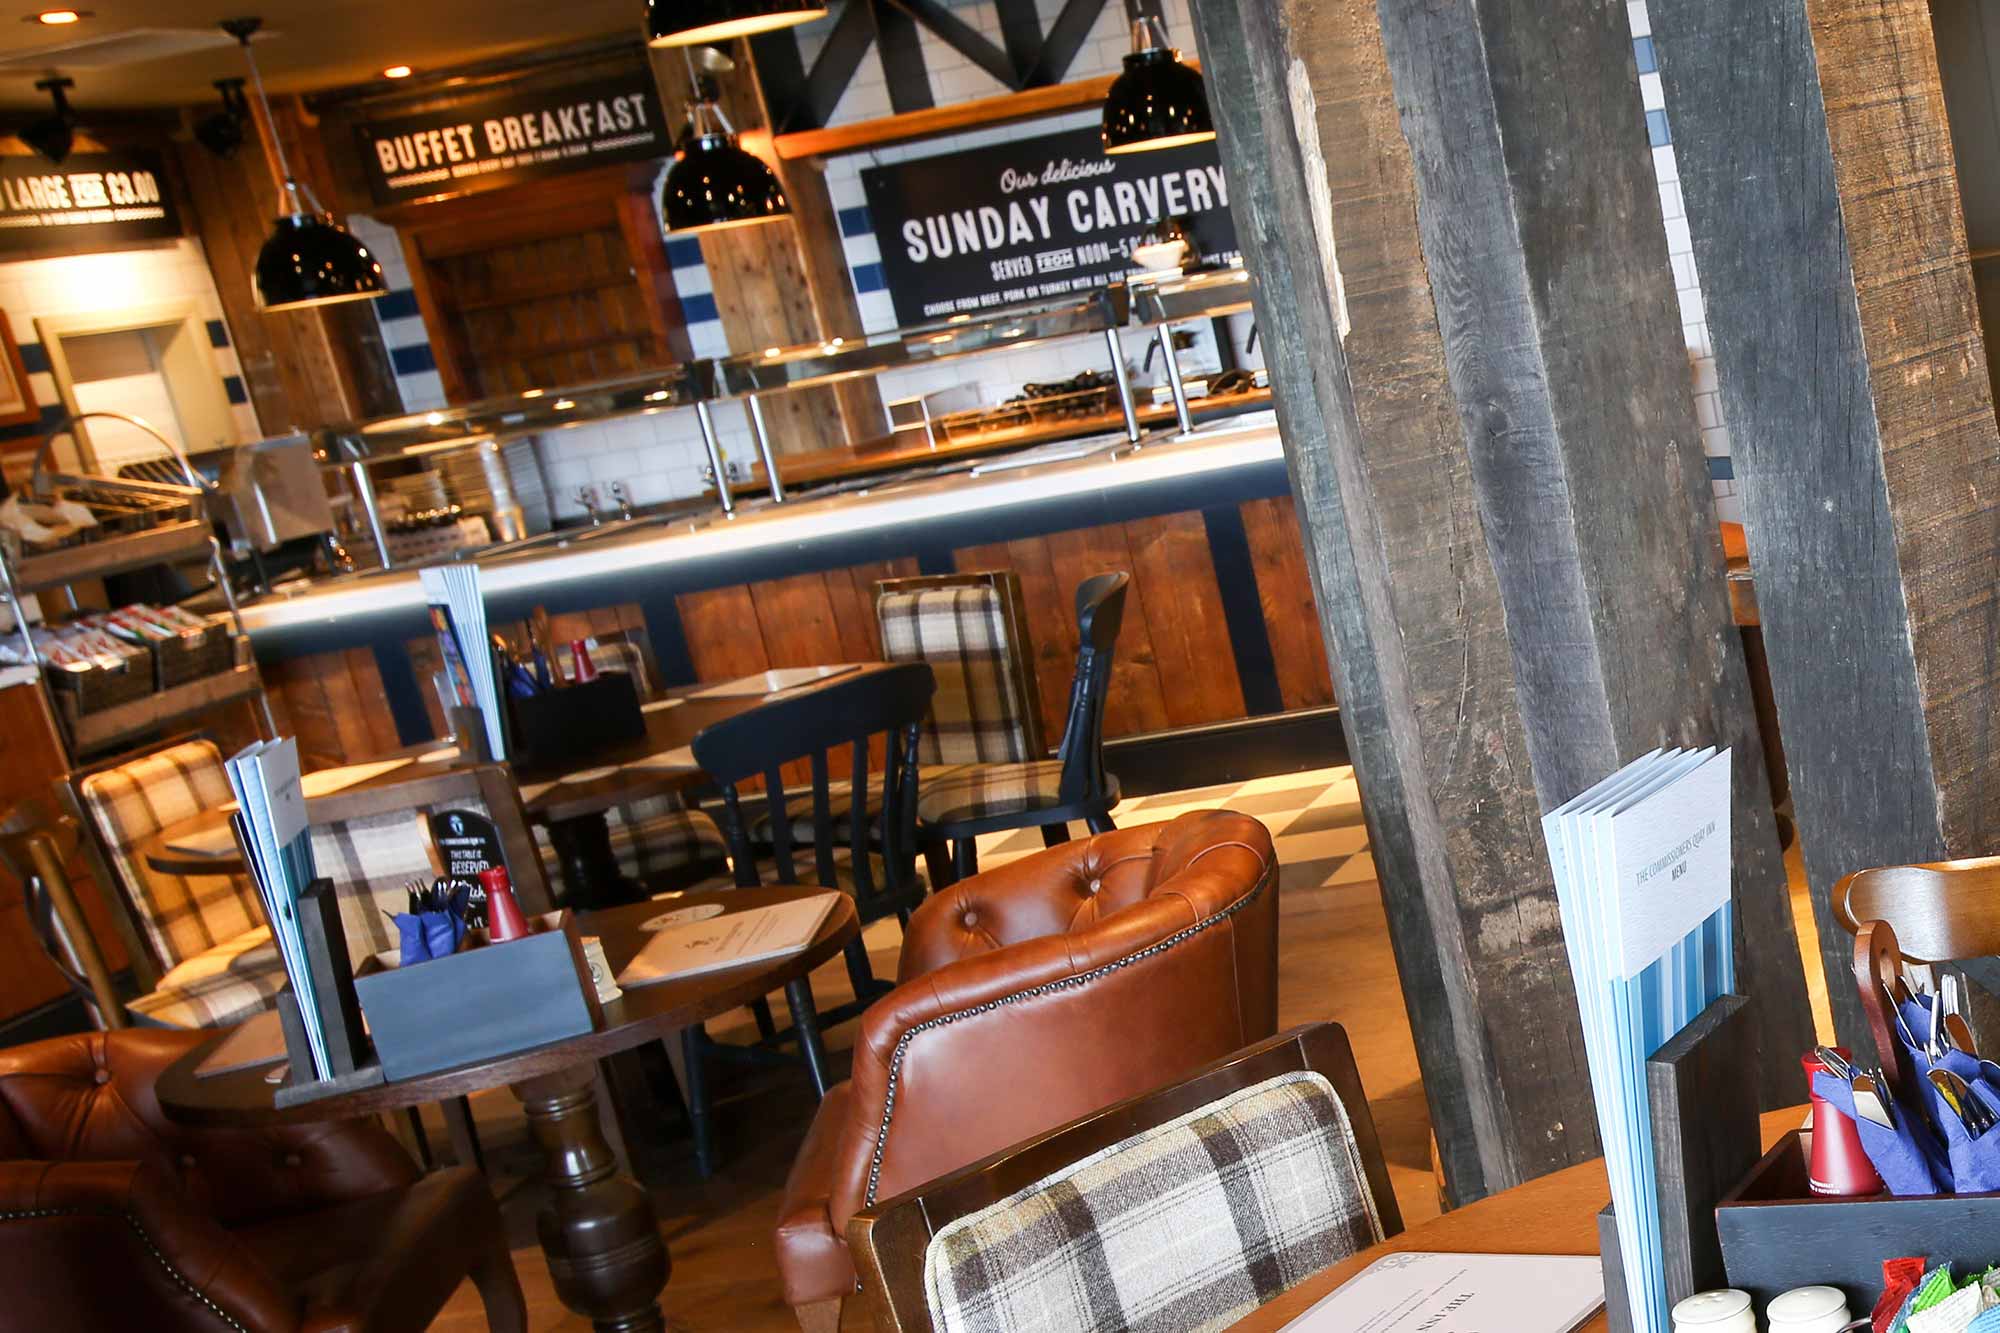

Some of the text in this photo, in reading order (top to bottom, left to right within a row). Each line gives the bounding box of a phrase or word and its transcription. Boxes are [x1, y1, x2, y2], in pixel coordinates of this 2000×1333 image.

[375, 124, 477, 175] BUFFET
[483, 93, 650, 155] BREAKFAST
[4, 174, 72, 210] LARGE
[1000, 158, 1116, 194] Our delicious
[903, 165, 1230, 263] SUNDAY CARVERY
[990, 255, 1034, 282] SERVED
[1036, 249, 1076, 272] FROM
[923, 299, 956, 317] CHOOSE
[956, 295, 981, 310] FROM
[1003, 287, 1026, 303] PORK
[1026, 285, 1040, 300] OR
[1039, 280, 1072, 297] TURKEY
[1072, 276, 1093, 291] WITH
[1093, 274, 1109, 288] ALL
[1671, 860, 1688, 882] MENU
